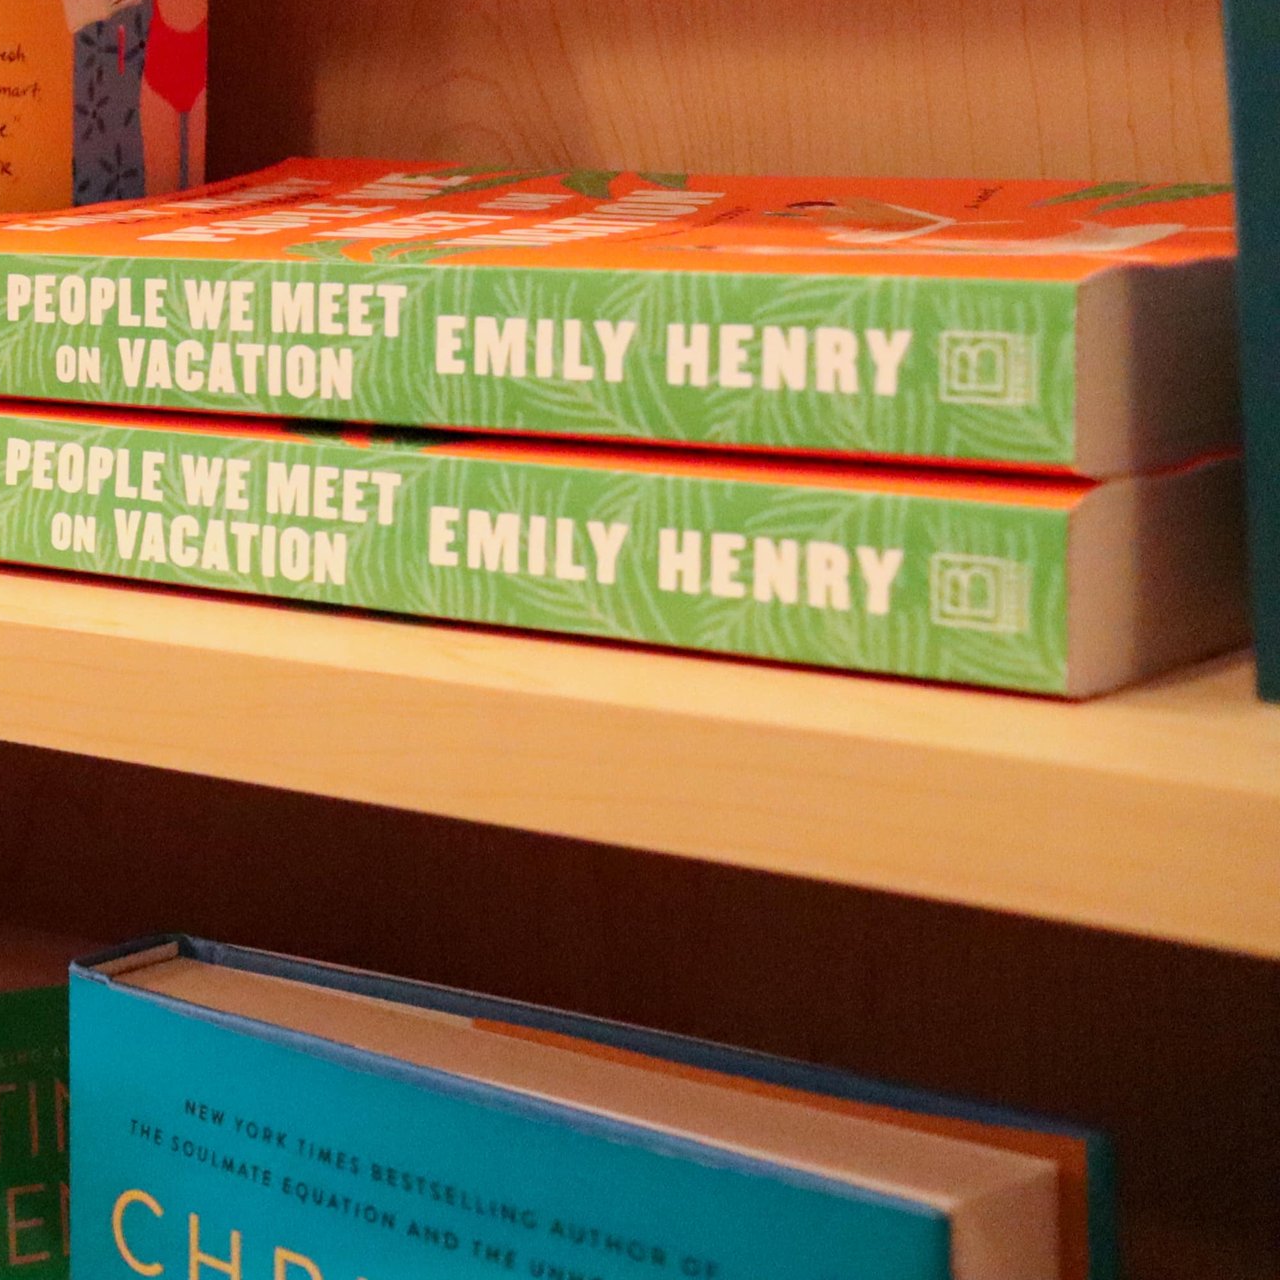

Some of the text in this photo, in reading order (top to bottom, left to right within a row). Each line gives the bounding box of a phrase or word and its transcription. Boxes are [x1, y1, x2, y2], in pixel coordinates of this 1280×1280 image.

[136, 202, 397, 243] PEOPLE
[311, 192, 574, 239] MEET ON
[434, 189, 726, 246] VACATION
[6, 273, 408, 339] PEOPLE WE MEET
[54, 337, 354, 401] ON VACATION
[434, 314, 913, 396] EMILY HENRY
[4, 437, 402, 524] PEOPLE WE MEET
[50, 506, 347, 586] ON VACATION
[427, 504, 629, 585] EMILY
[657, 527, 904, 616] HENRY
[130, 1118, 163, 1146] THE
[171, 1134, 272, 1187] SOULMATE
[282, 1175, 395, 1231] EQUATION
[406, 1220, 459, 1251] AND
[470, 1237, 517, 1269] THE
[184, 1098, 225, 1126] NEW
[235, 1119, 288, 1149] YORK
[298, 1138, 360, 1175] TIMES
[370, 1162, 538, 1231] BESTSELLING
[549, 1219, 667, 1266] AUTHOR
